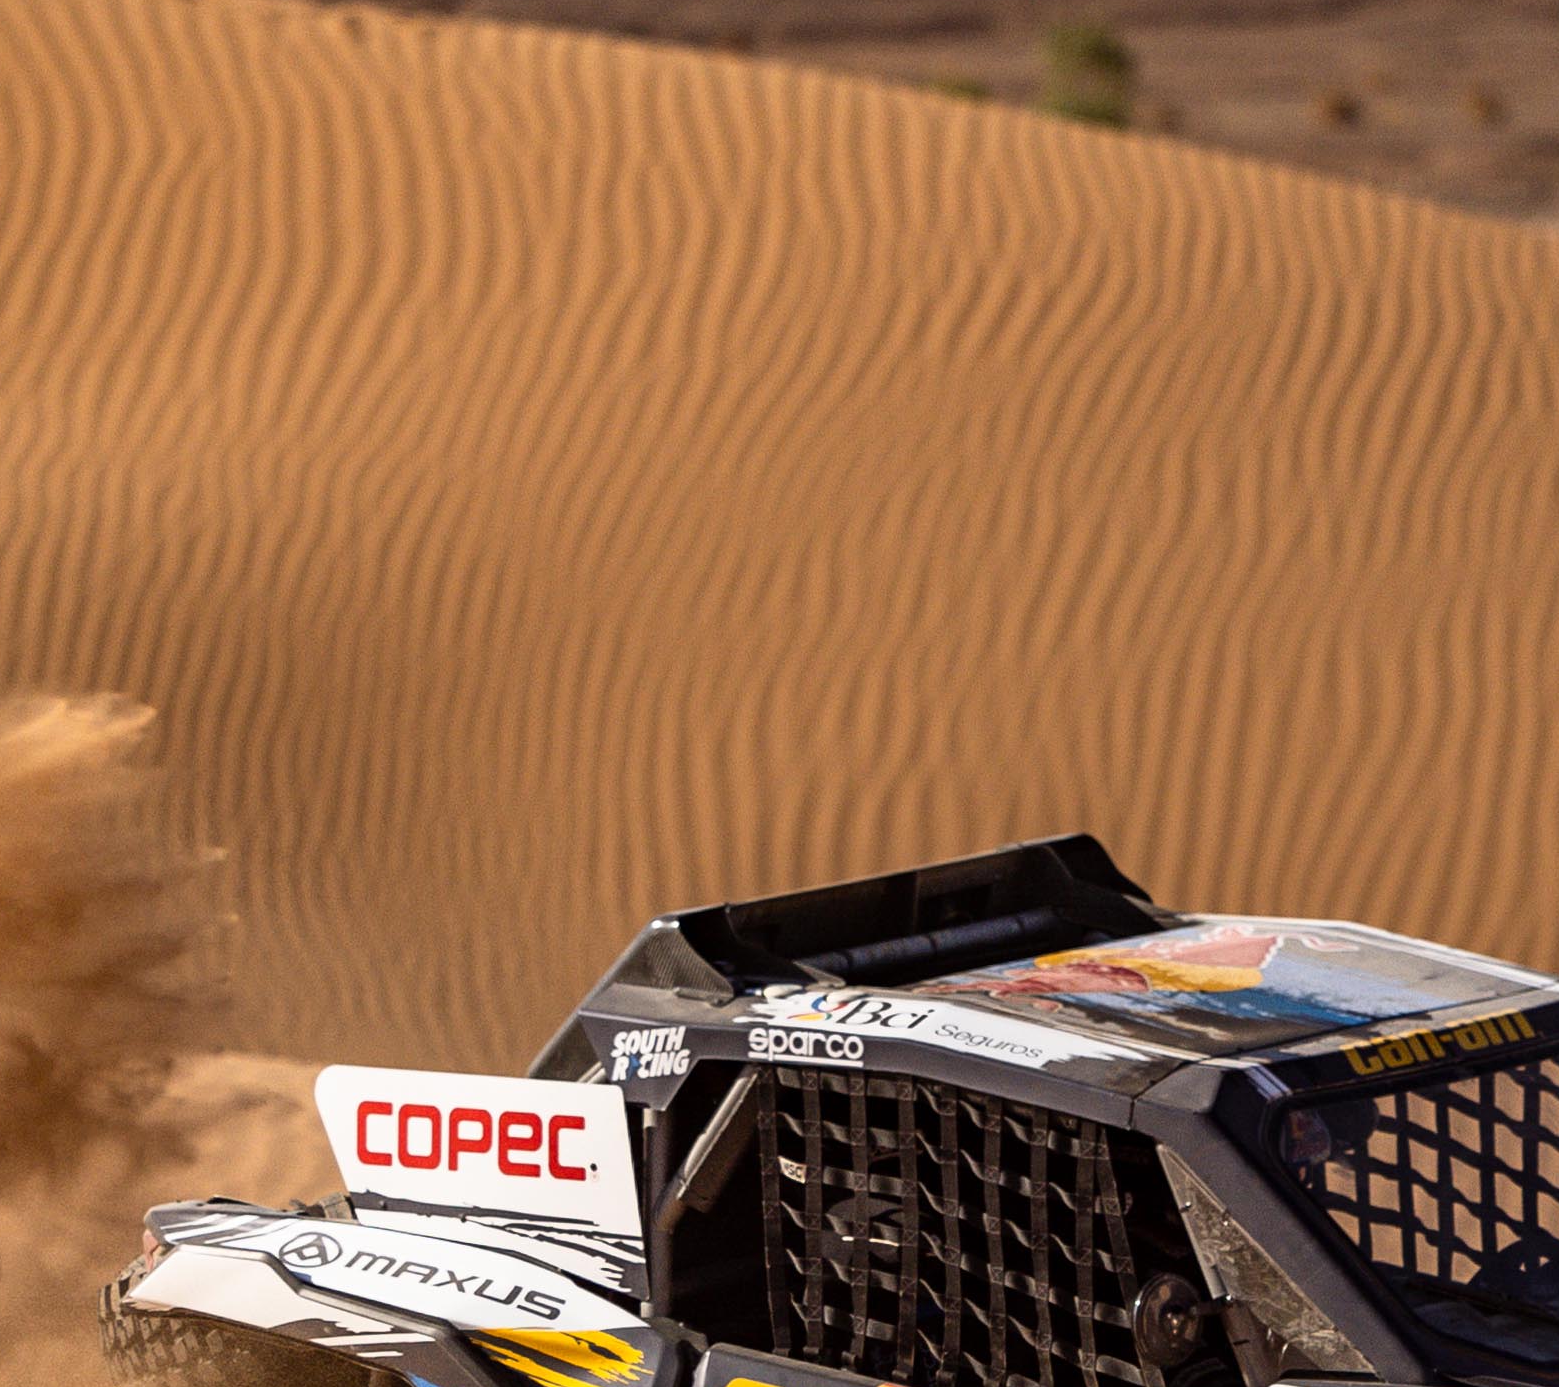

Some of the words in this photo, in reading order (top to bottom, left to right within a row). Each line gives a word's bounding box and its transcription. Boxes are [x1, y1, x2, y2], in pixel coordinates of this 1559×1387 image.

[610, 1026, 686, 1056] SOUTH
[747, 1027, 864, 1063] sparco
[835, 999, 935, 1029] Bci
[934, 1023, 1043, 1059] Seguros
[1340, 1008, 1536, 1076] can-am
[345, 1250, 567, 1321] MAXUS
